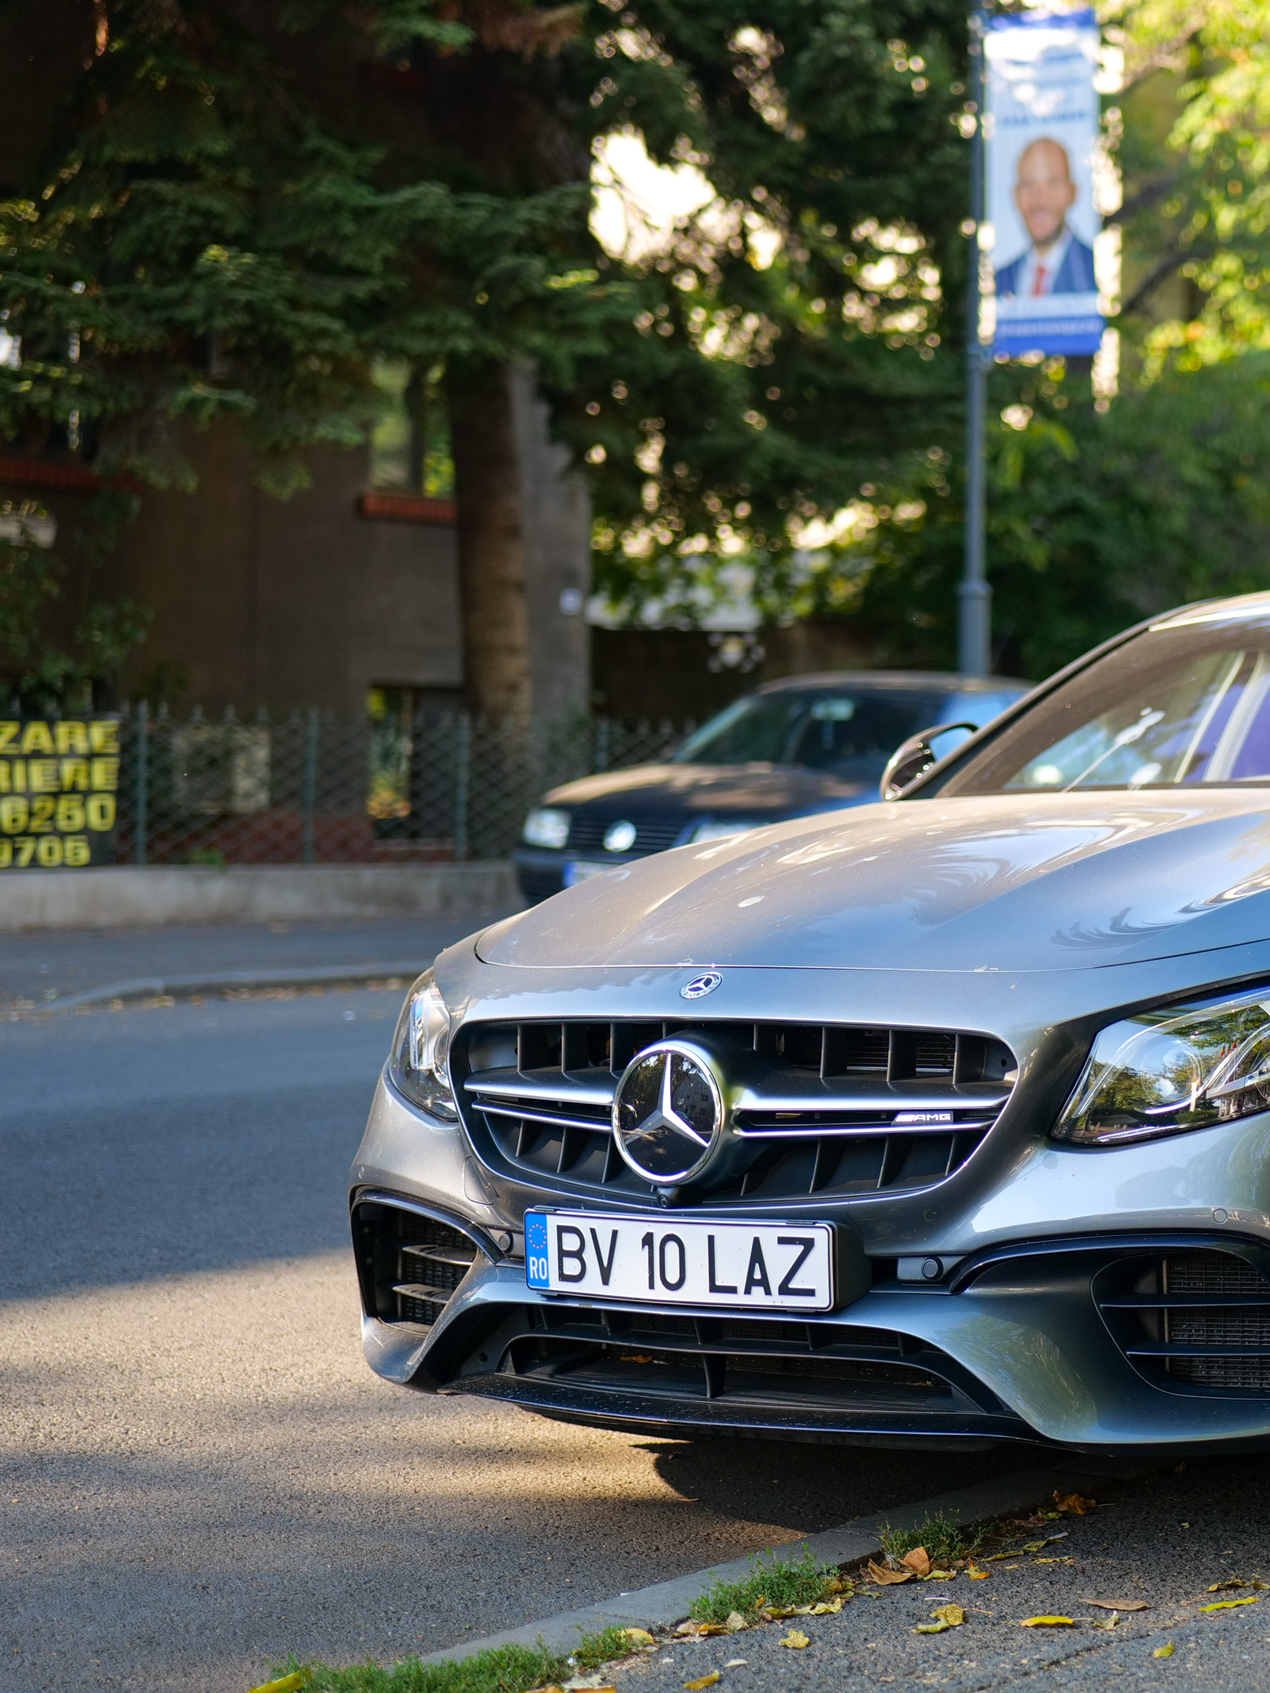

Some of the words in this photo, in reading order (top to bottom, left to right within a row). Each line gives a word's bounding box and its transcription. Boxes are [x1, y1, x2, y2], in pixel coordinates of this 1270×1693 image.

[913, 1113, 951, 1122] AMG
[529, 1256, 548, 1280] RO
[556, 1224, 619, 1286] BV
[641, 1231, 686, 1292] 10
[707, 1234, 816, 1297] LAZ
